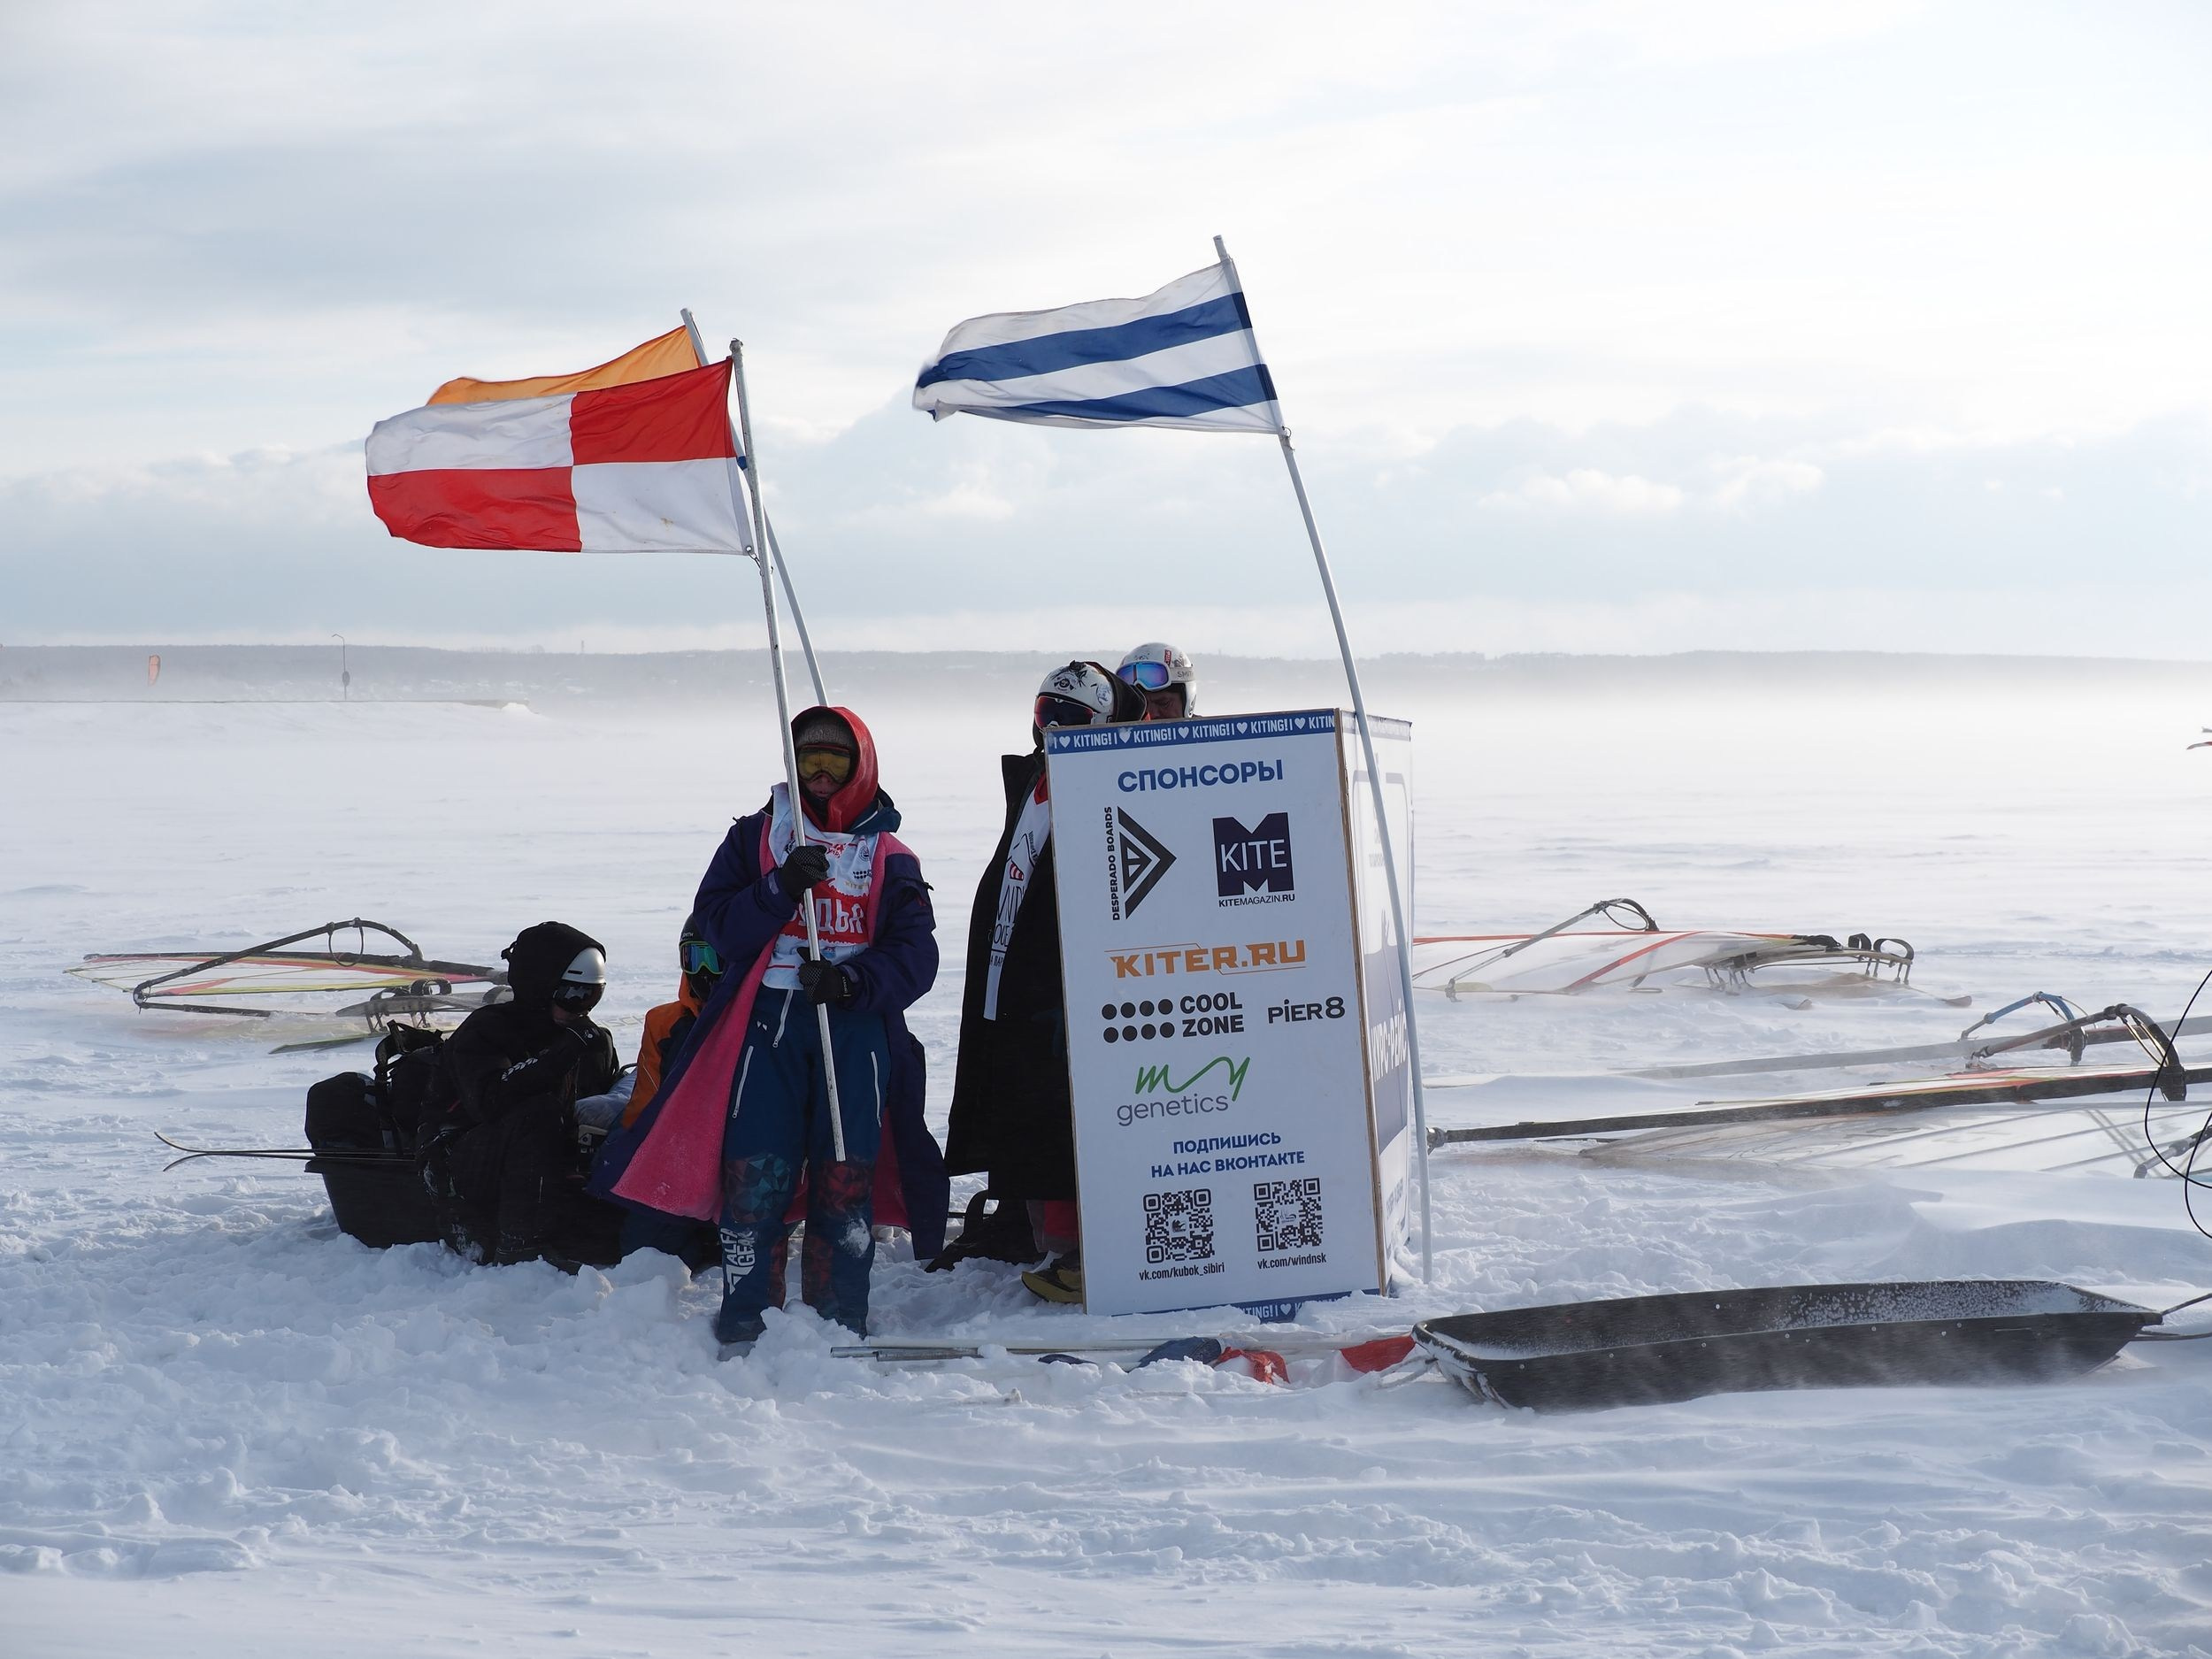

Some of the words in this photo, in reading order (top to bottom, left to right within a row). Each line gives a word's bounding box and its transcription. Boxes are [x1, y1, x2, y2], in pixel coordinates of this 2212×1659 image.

[1073, 733, 1112, 748] KITING!
[1133, 727, 1172, 743] KITING!
[1192, 722, 1231, 739] KITING!
[1250, 718, 1289, 733] KITING!
[1118, 759, 1284, 793] СПОНСОРЫ
[1104, 806, 1115, 852] BOARDS
[1220, 839, 1287, 872] KITE
[1109, 855, 1120, 921] DESPERADO
[1218, 894, 1295, 908] KITEMAGAZIN.RU
[790, 898, 864, 934] УДЬЯ
[1110, 940, 1306, 979] KITER.RU
[1179, 991, 1243, 1014] COOL
[1181, 1015, 1245, 1038] ZONE
[1117, 1093, 1229, 1127] genetics
[1173, 1132, 1281, 1155] ПОДПИШИСЬ
[1151, 1164, 1175, 1179] НА
[1178, 1160, 1211, 1176] НАС
[1215, 1150, 1305, 1172] ВКОНТАКТЕ
[1139, 1262, 1225, 1281] vk.com/kubok_sibiri
[1257, 1252, 1327, 1270] vk.com/windnsk
[1242, 1303, 1274, 1318] TING!
